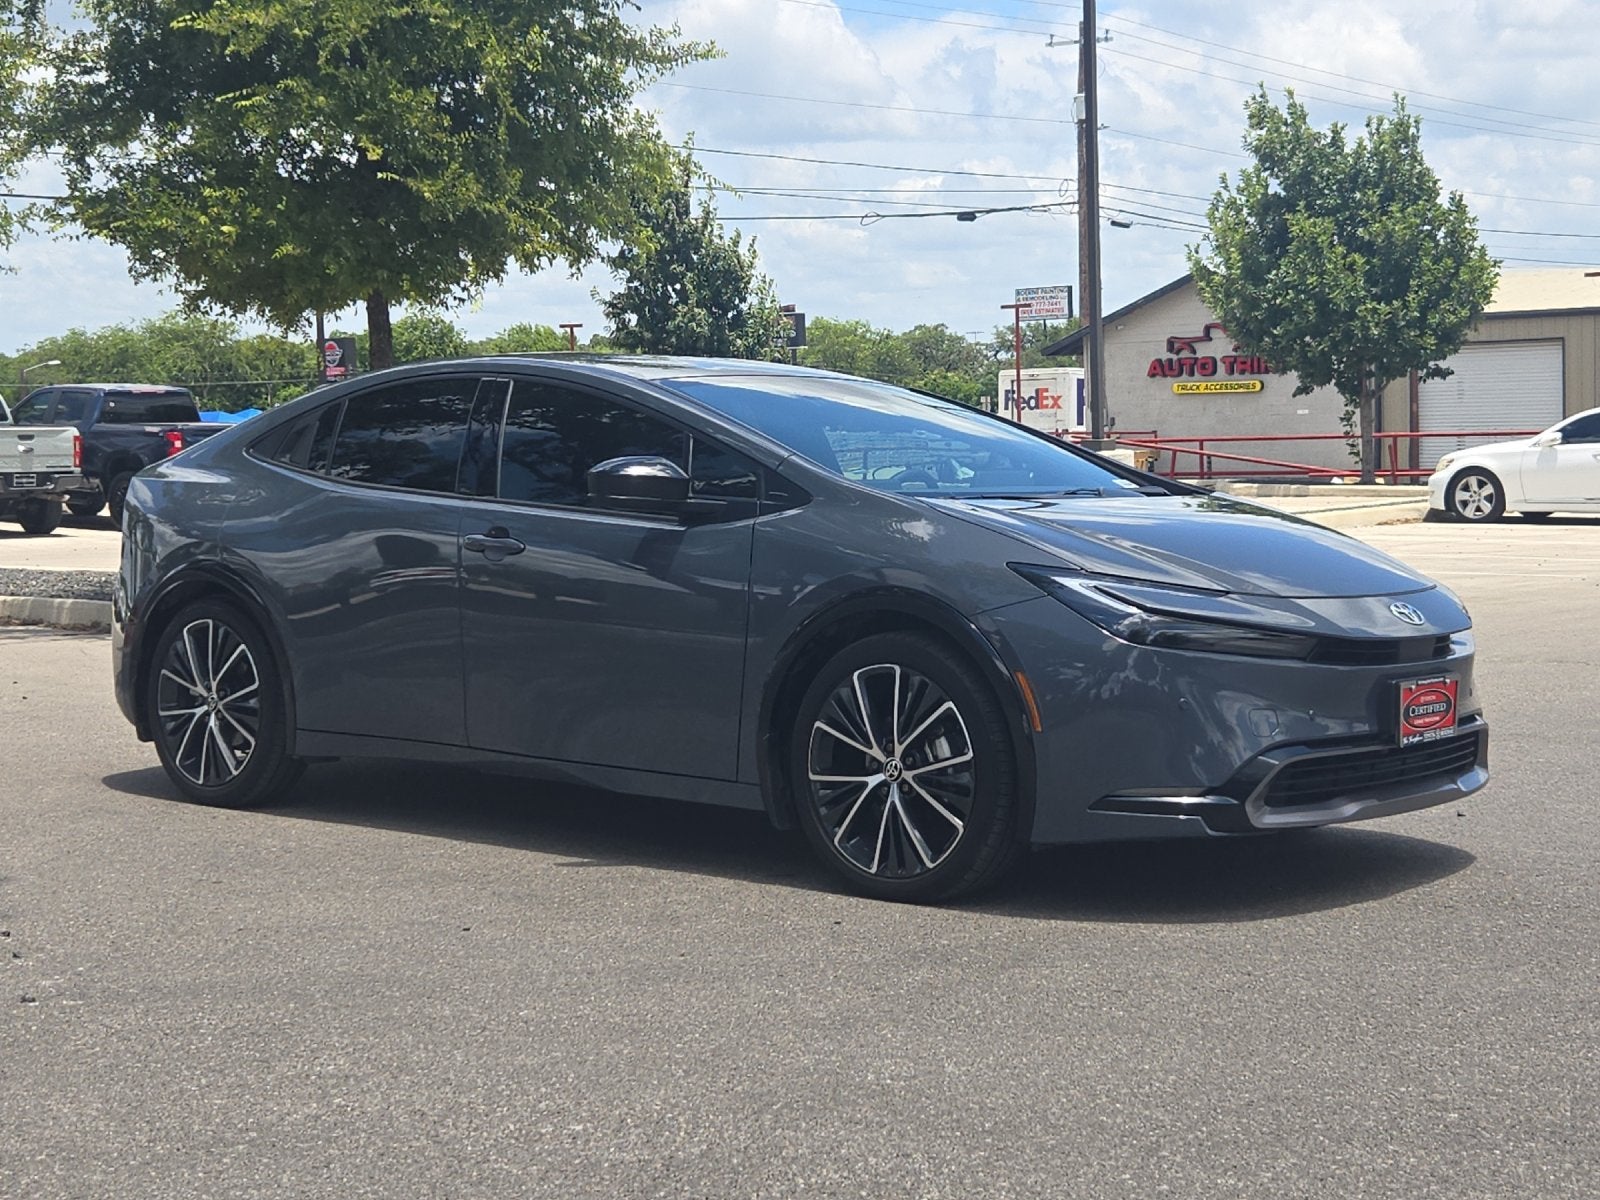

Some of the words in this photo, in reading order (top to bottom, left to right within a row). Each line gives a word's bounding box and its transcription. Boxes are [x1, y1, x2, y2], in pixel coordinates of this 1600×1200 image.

[1040, 287, 1068, 295] PAINTING
[1147, 356, 1217, 378] AUTO
[1220, 355, 1270, 375] TRI
[1176, 383, 1202, 392] TRUCK
[1203, 382, 1257, 391] ACCESSORIES
[1004, 387, 1063, 411] FedEx
